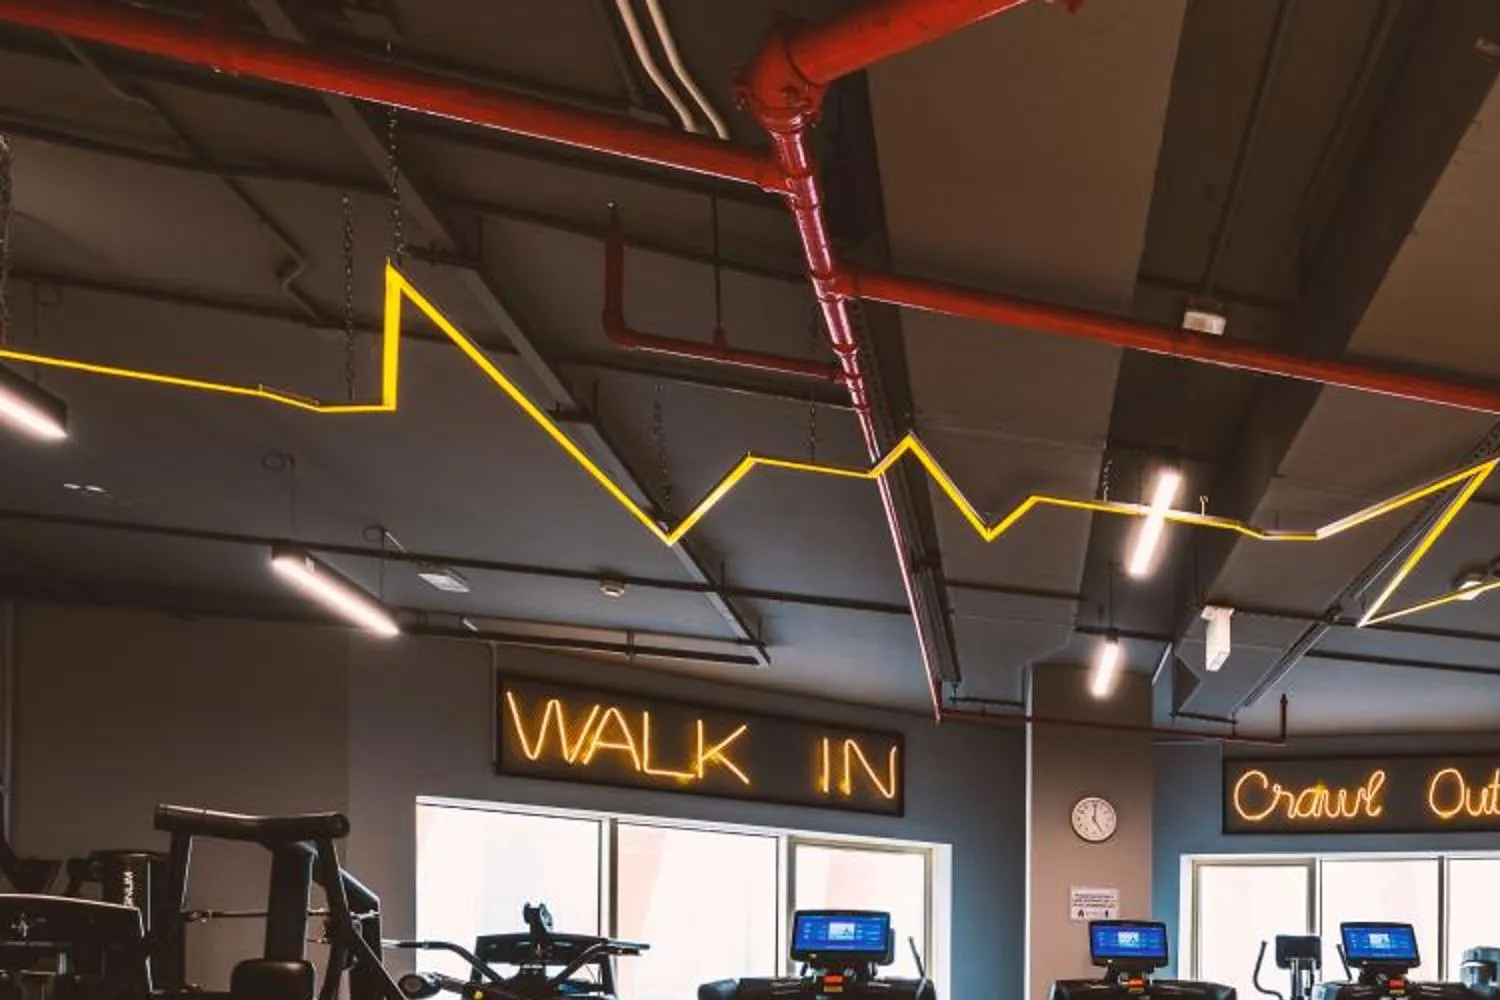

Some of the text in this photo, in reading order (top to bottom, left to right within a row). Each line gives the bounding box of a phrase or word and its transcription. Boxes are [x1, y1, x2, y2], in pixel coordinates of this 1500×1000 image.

[506, 691, 897, 799] WALK IN
[1233, 769, 1386, 821] Crawl
